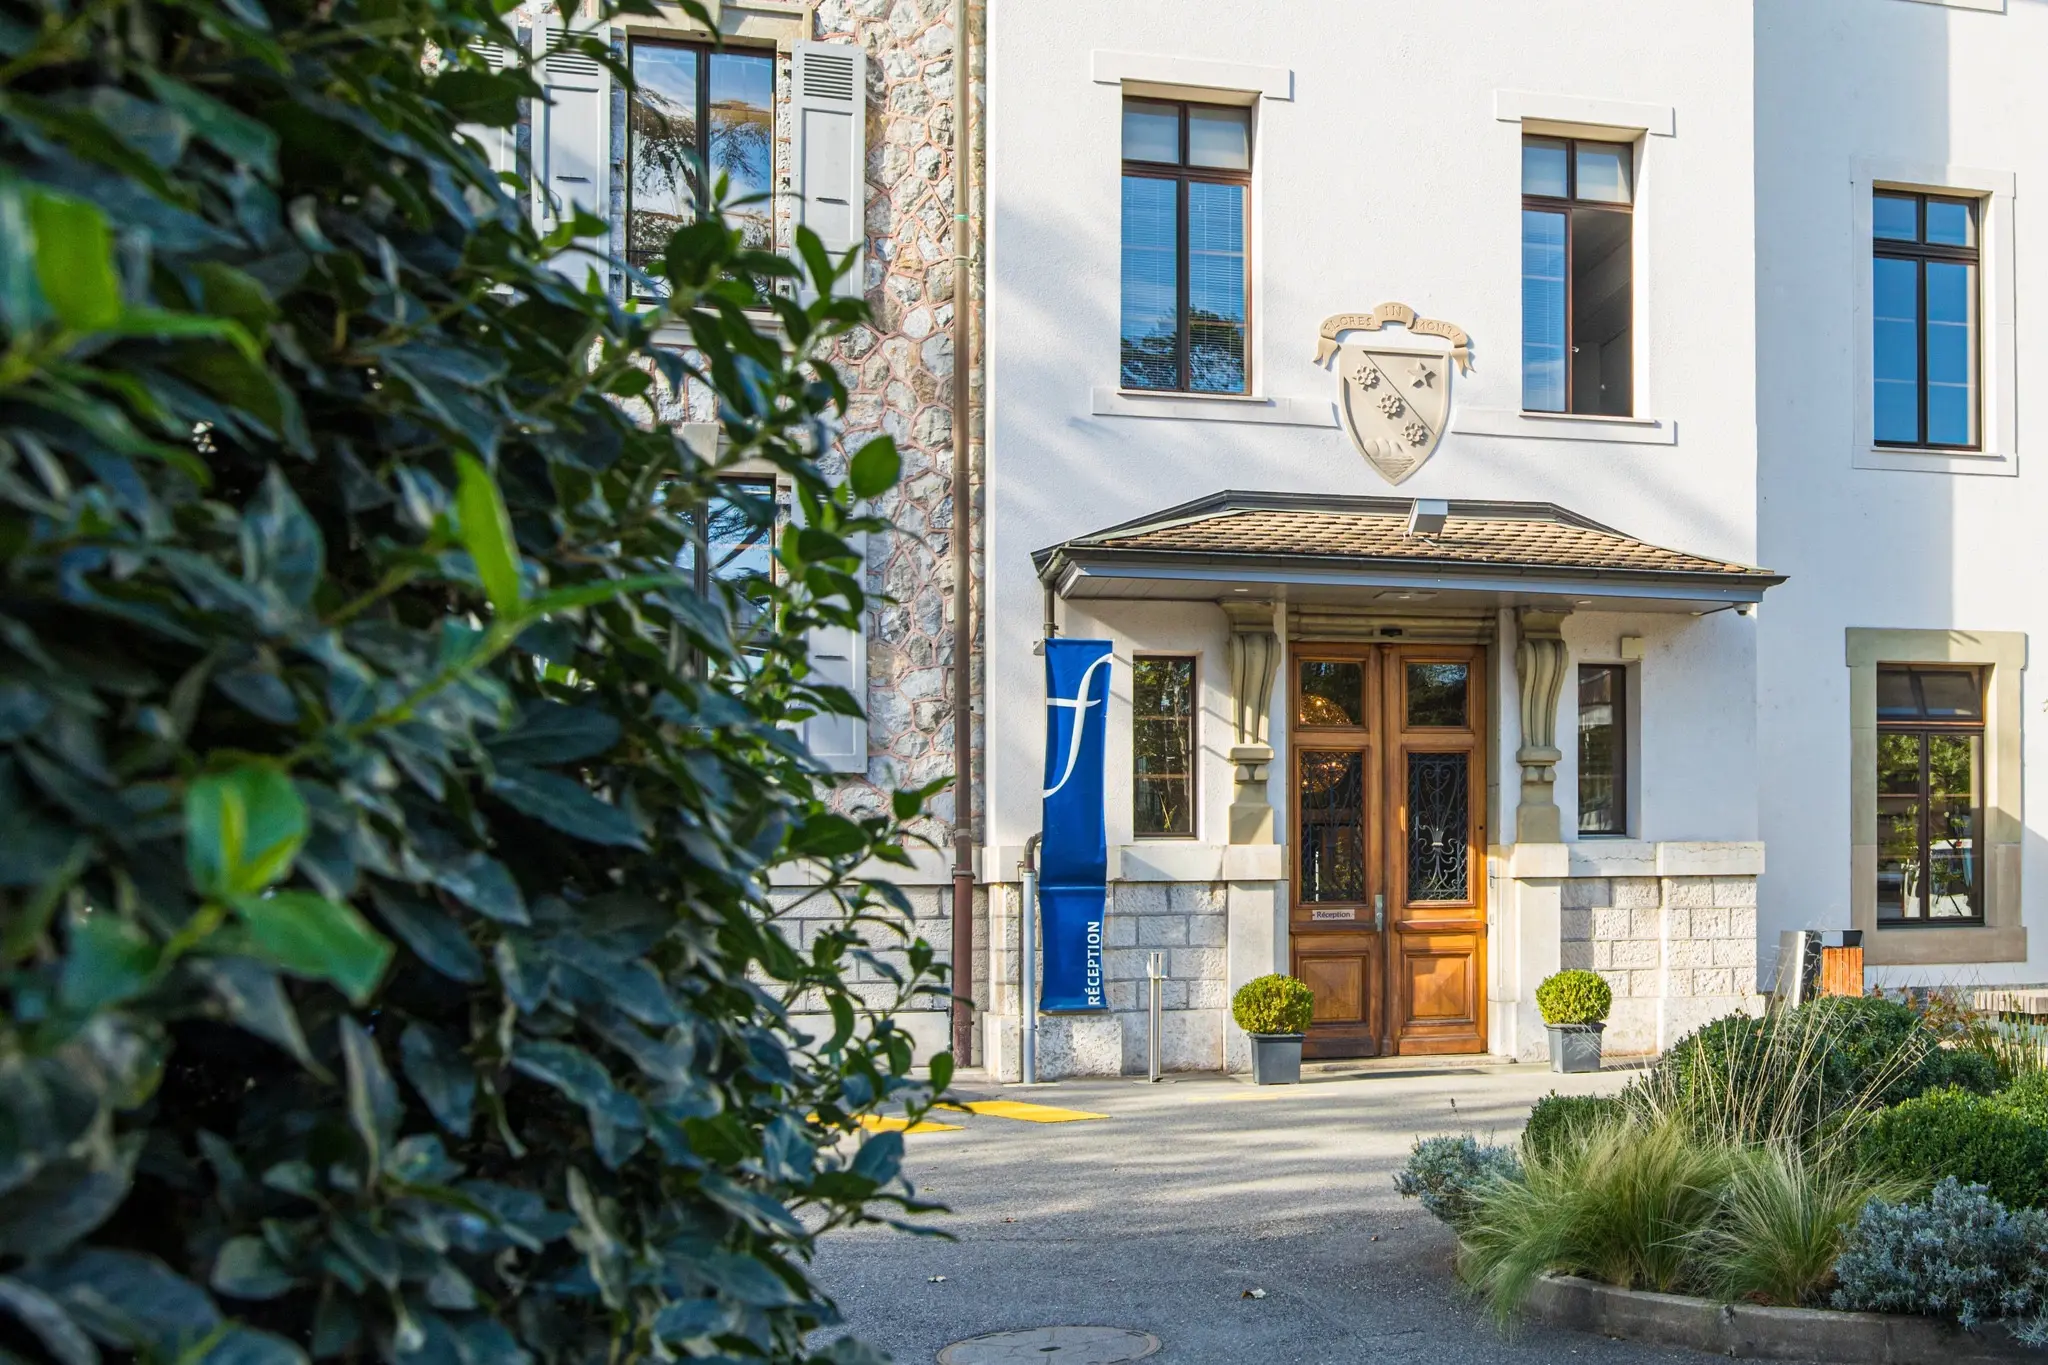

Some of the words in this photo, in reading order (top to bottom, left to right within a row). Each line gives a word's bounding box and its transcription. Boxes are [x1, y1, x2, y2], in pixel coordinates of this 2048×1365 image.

[1323, 316, 1372, 332] FLORES
[1384, 305, 1403, 317] IN
[1316, 911, 1351, 919] Réception
[1084, 921, 1101, 1006] RÉCEPTION
